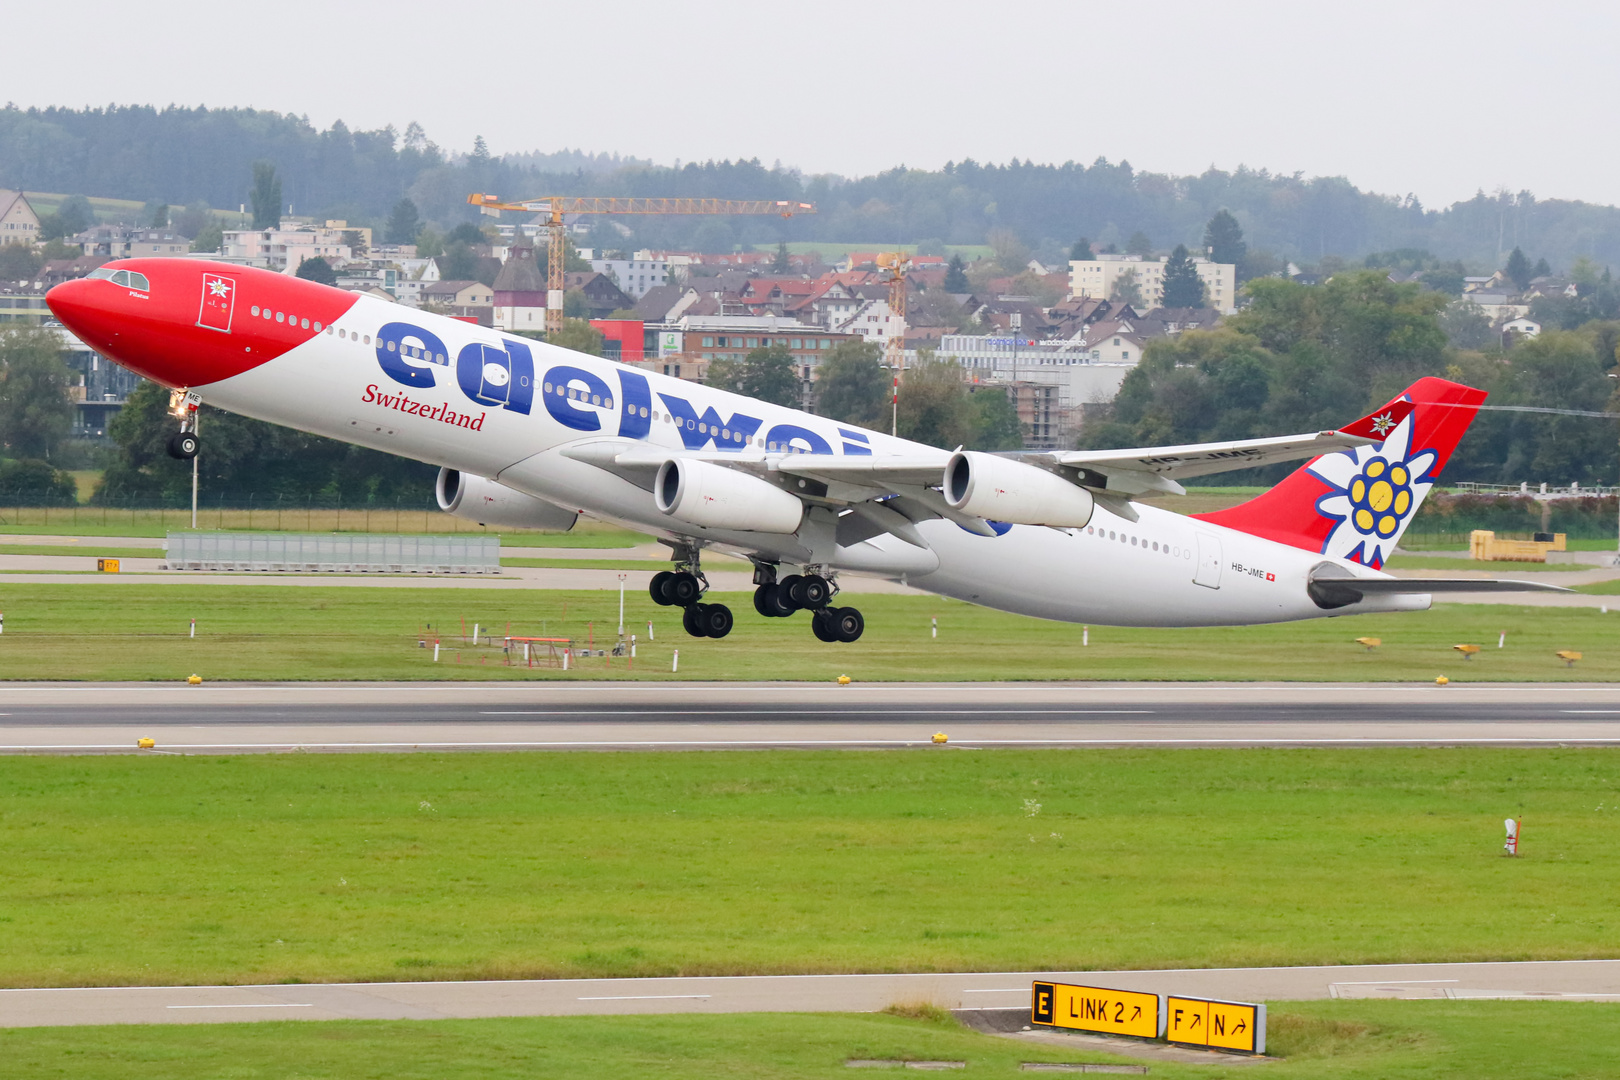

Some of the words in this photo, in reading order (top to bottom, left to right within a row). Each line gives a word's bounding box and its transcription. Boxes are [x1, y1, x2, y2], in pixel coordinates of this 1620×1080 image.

[188, 393, 200, 402] ME
[361, 384, 486, 432] Switzerland
[1231, 561, 1264, 579] HB-JME
[1038, 992, 1049, 1015] E
[1070, 996, 1108, 1021] LINK
[1114, 1001, 1124, 1023] 2
[1174, 1009, 1184, 1031] F
[1214, 1013, 1225, 1036] N
